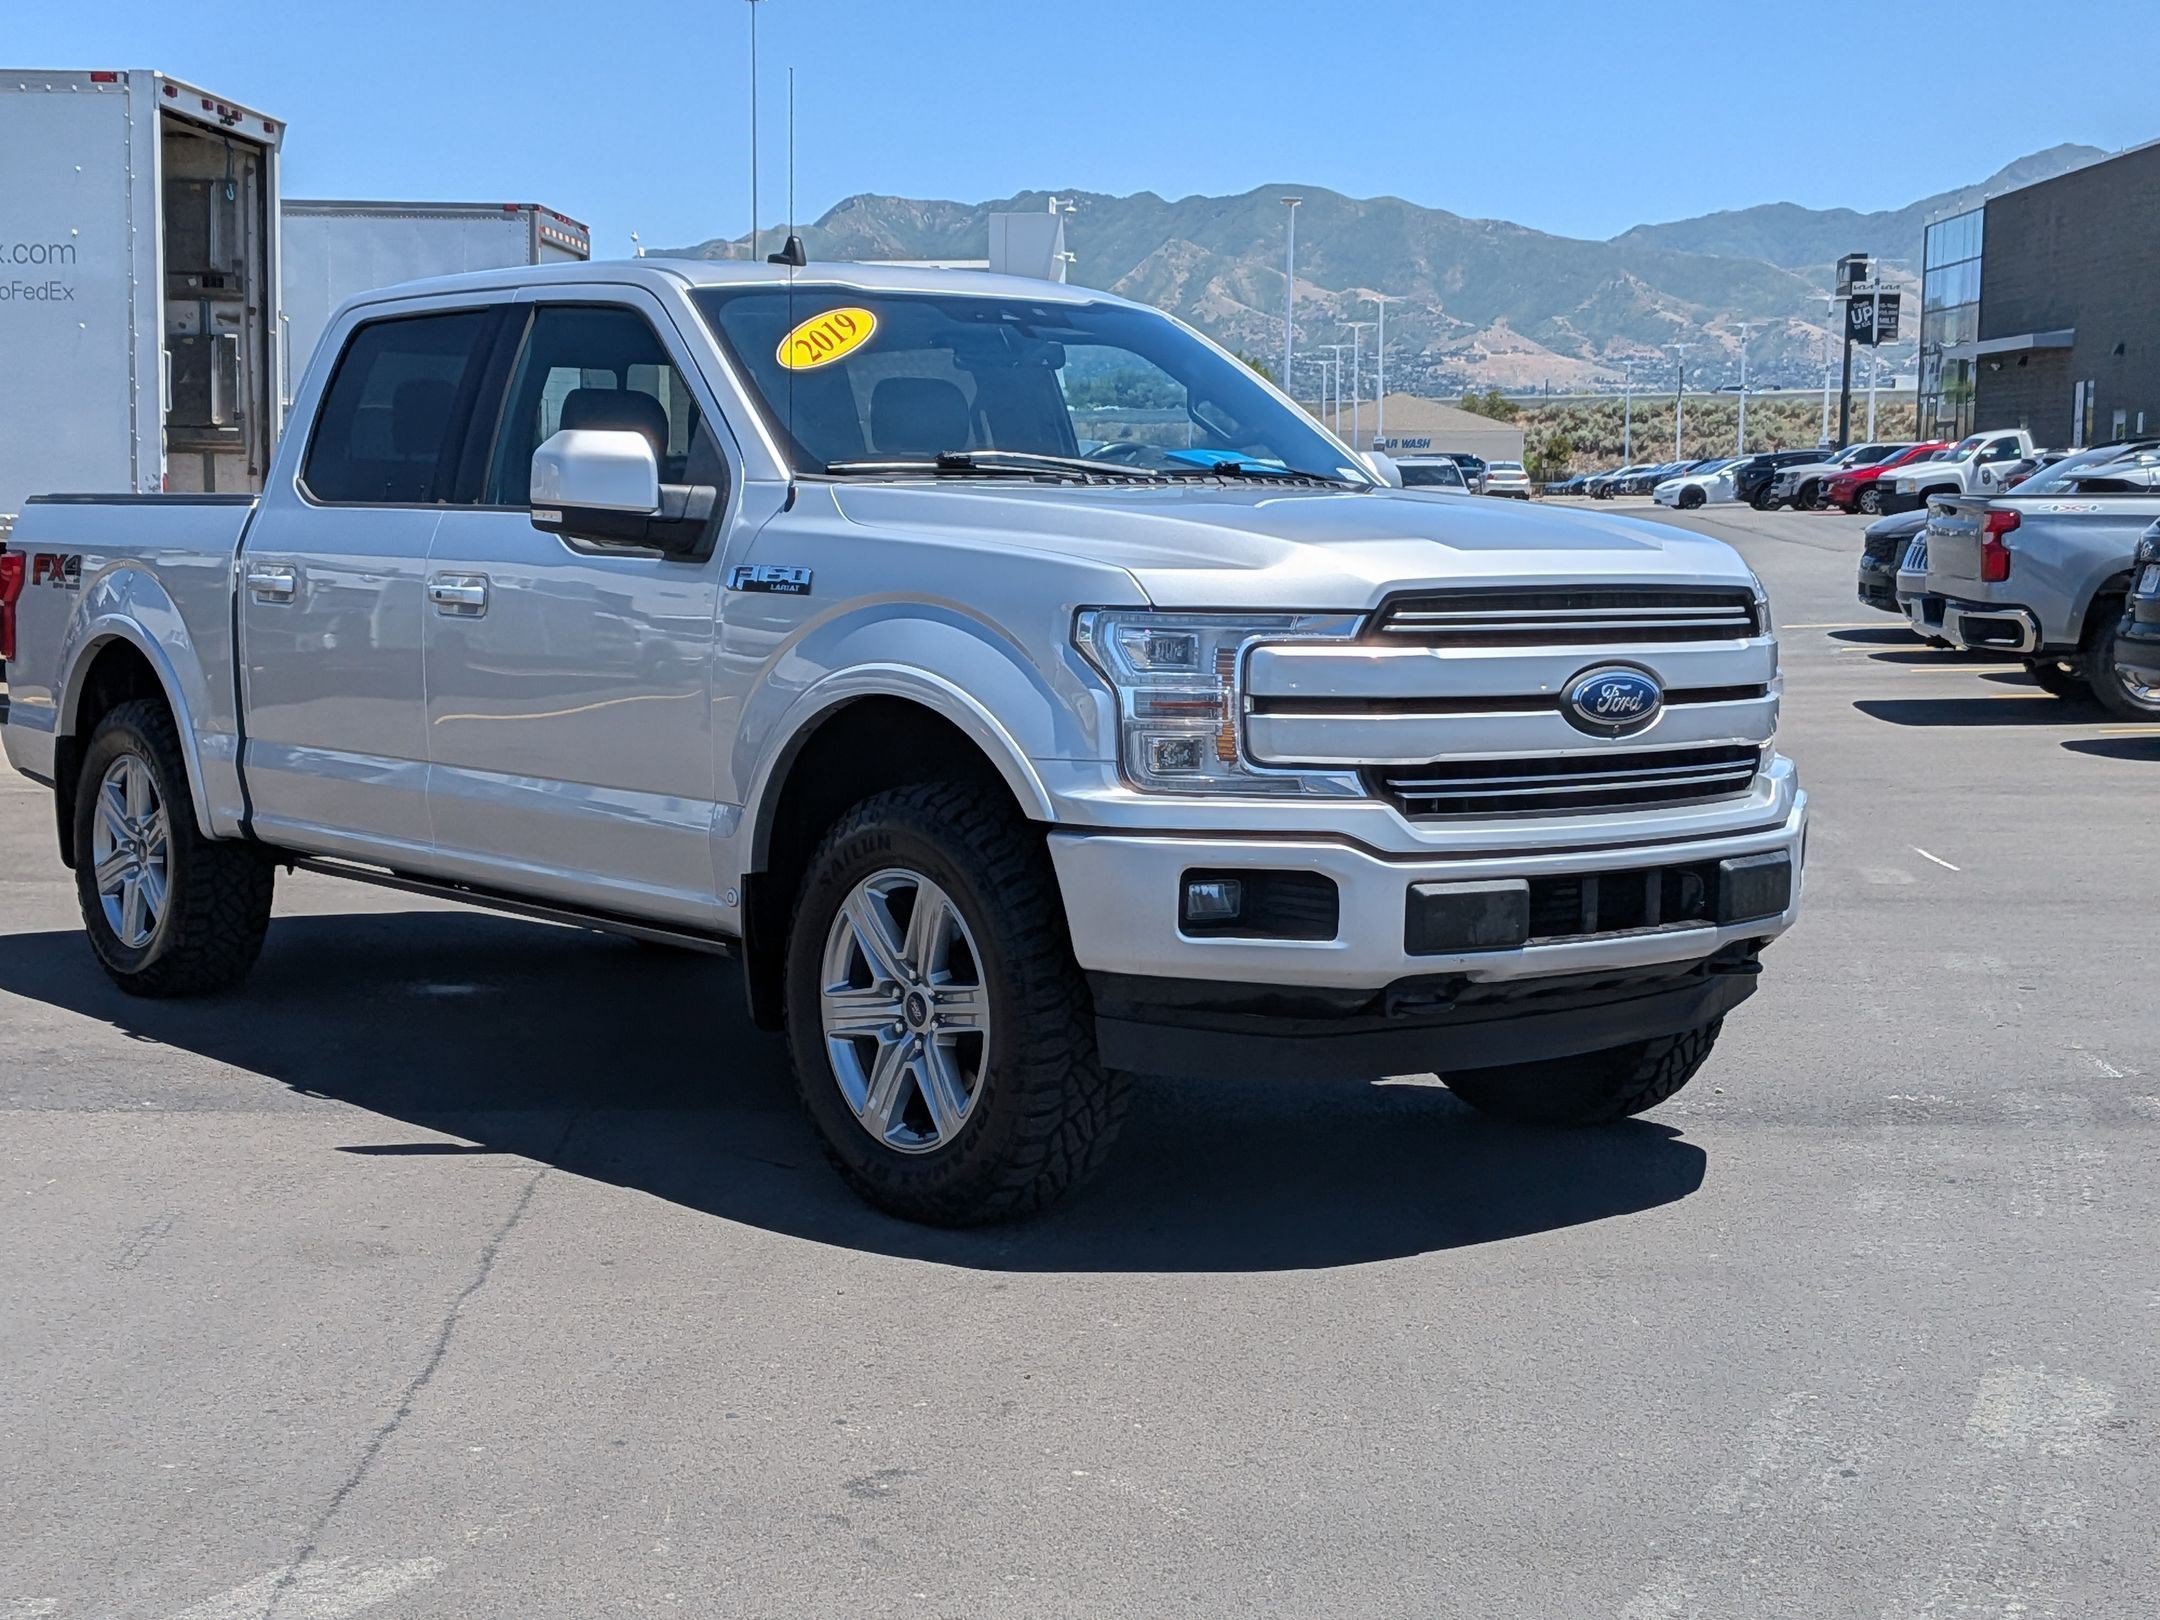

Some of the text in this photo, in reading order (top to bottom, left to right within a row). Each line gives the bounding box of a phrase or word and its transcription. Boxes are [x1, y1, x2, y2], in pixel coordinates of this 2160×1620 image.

[1851, 305, 1873, 324] UP
[795, 313, 857, 362] 2019
[1401, 438, 1431, 449] WASH
[32, 553, 82, 585] FX4
[770, 583, 801, 592] LARIAT
[1596, 683, 1645, 713] Ford
